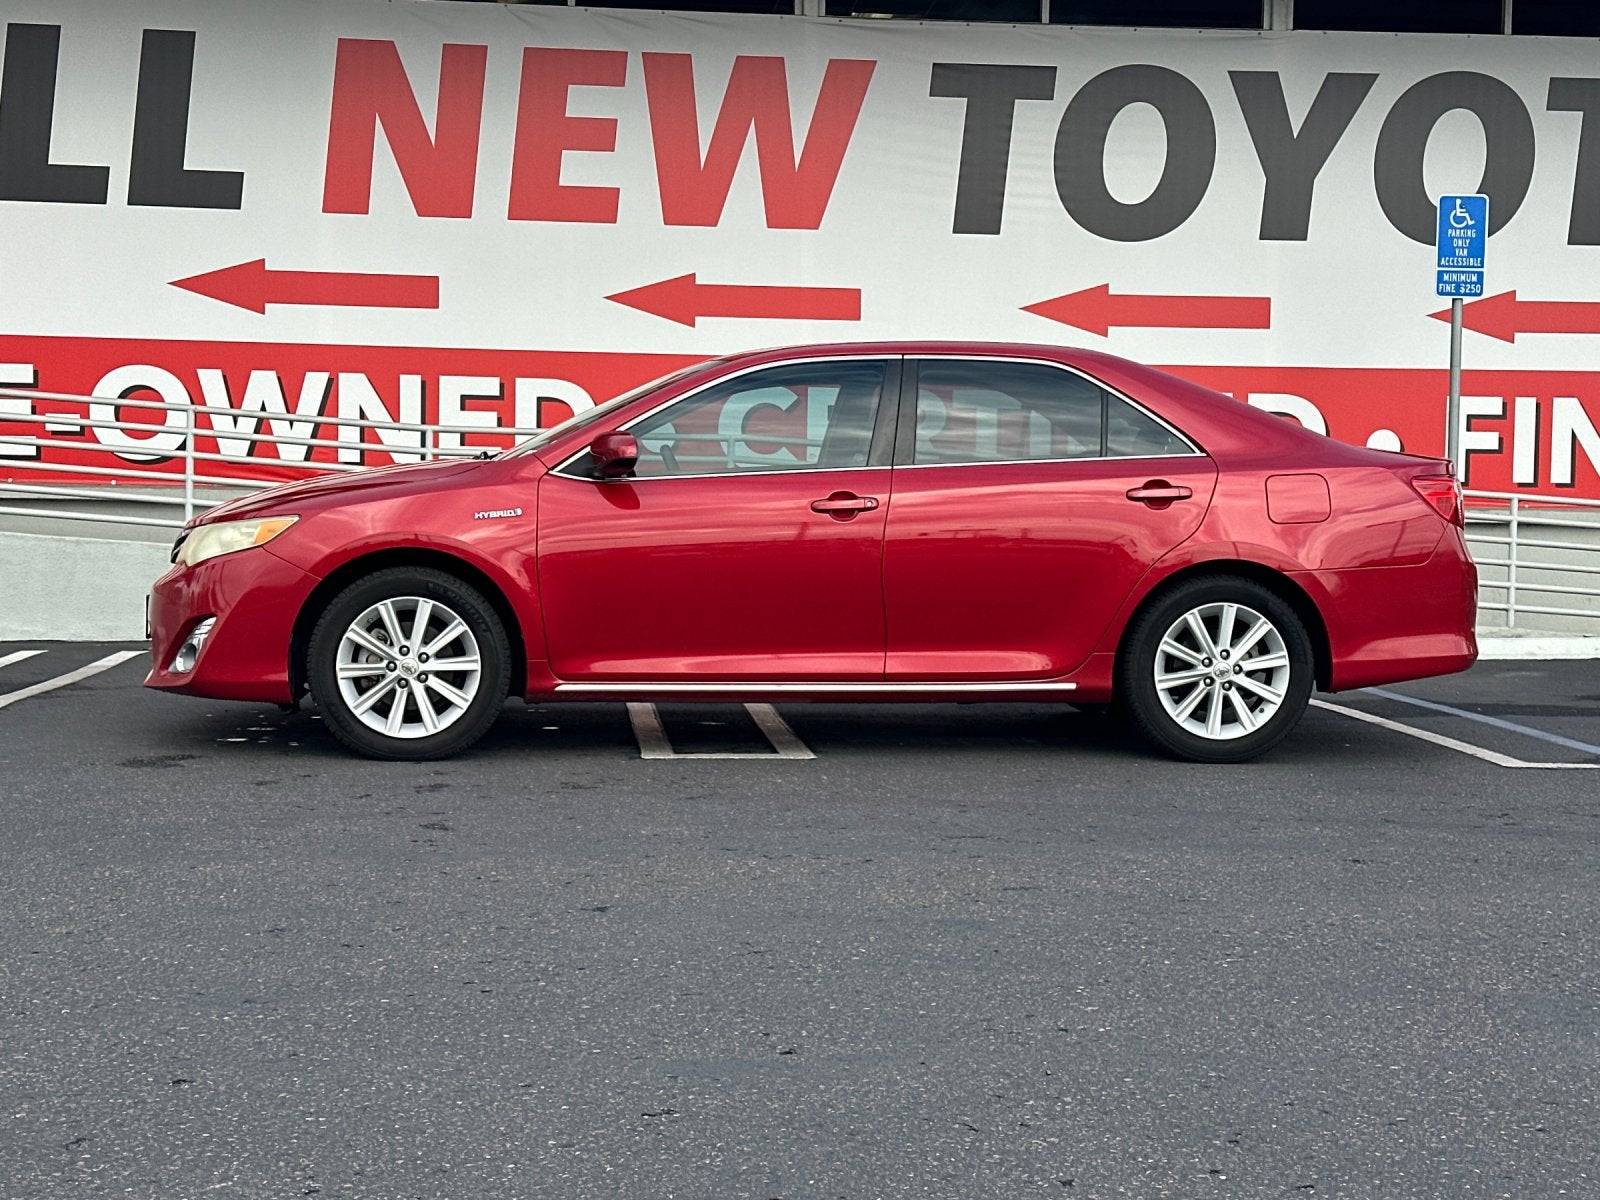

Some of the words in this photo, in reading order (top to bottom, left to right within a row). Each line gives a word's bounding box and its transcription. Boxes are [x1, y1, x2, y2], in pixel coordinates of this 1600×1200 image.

[321, 38, 877, 229] NEW
[1448, 229, 1476, 237] PARKING
[1453, 239, 1470, 247] ONLY
[1456, 248, 1468, 256] VAN
[1441, 257, 1481, 266] ACCESSIBLE
[1443, 273, 1477, 282] MINIMUM
[1439, 284, 1456, 292] FINE
[1459, 284, 1480, 293] $250
[474, 509, 516, 519] HYBRID
